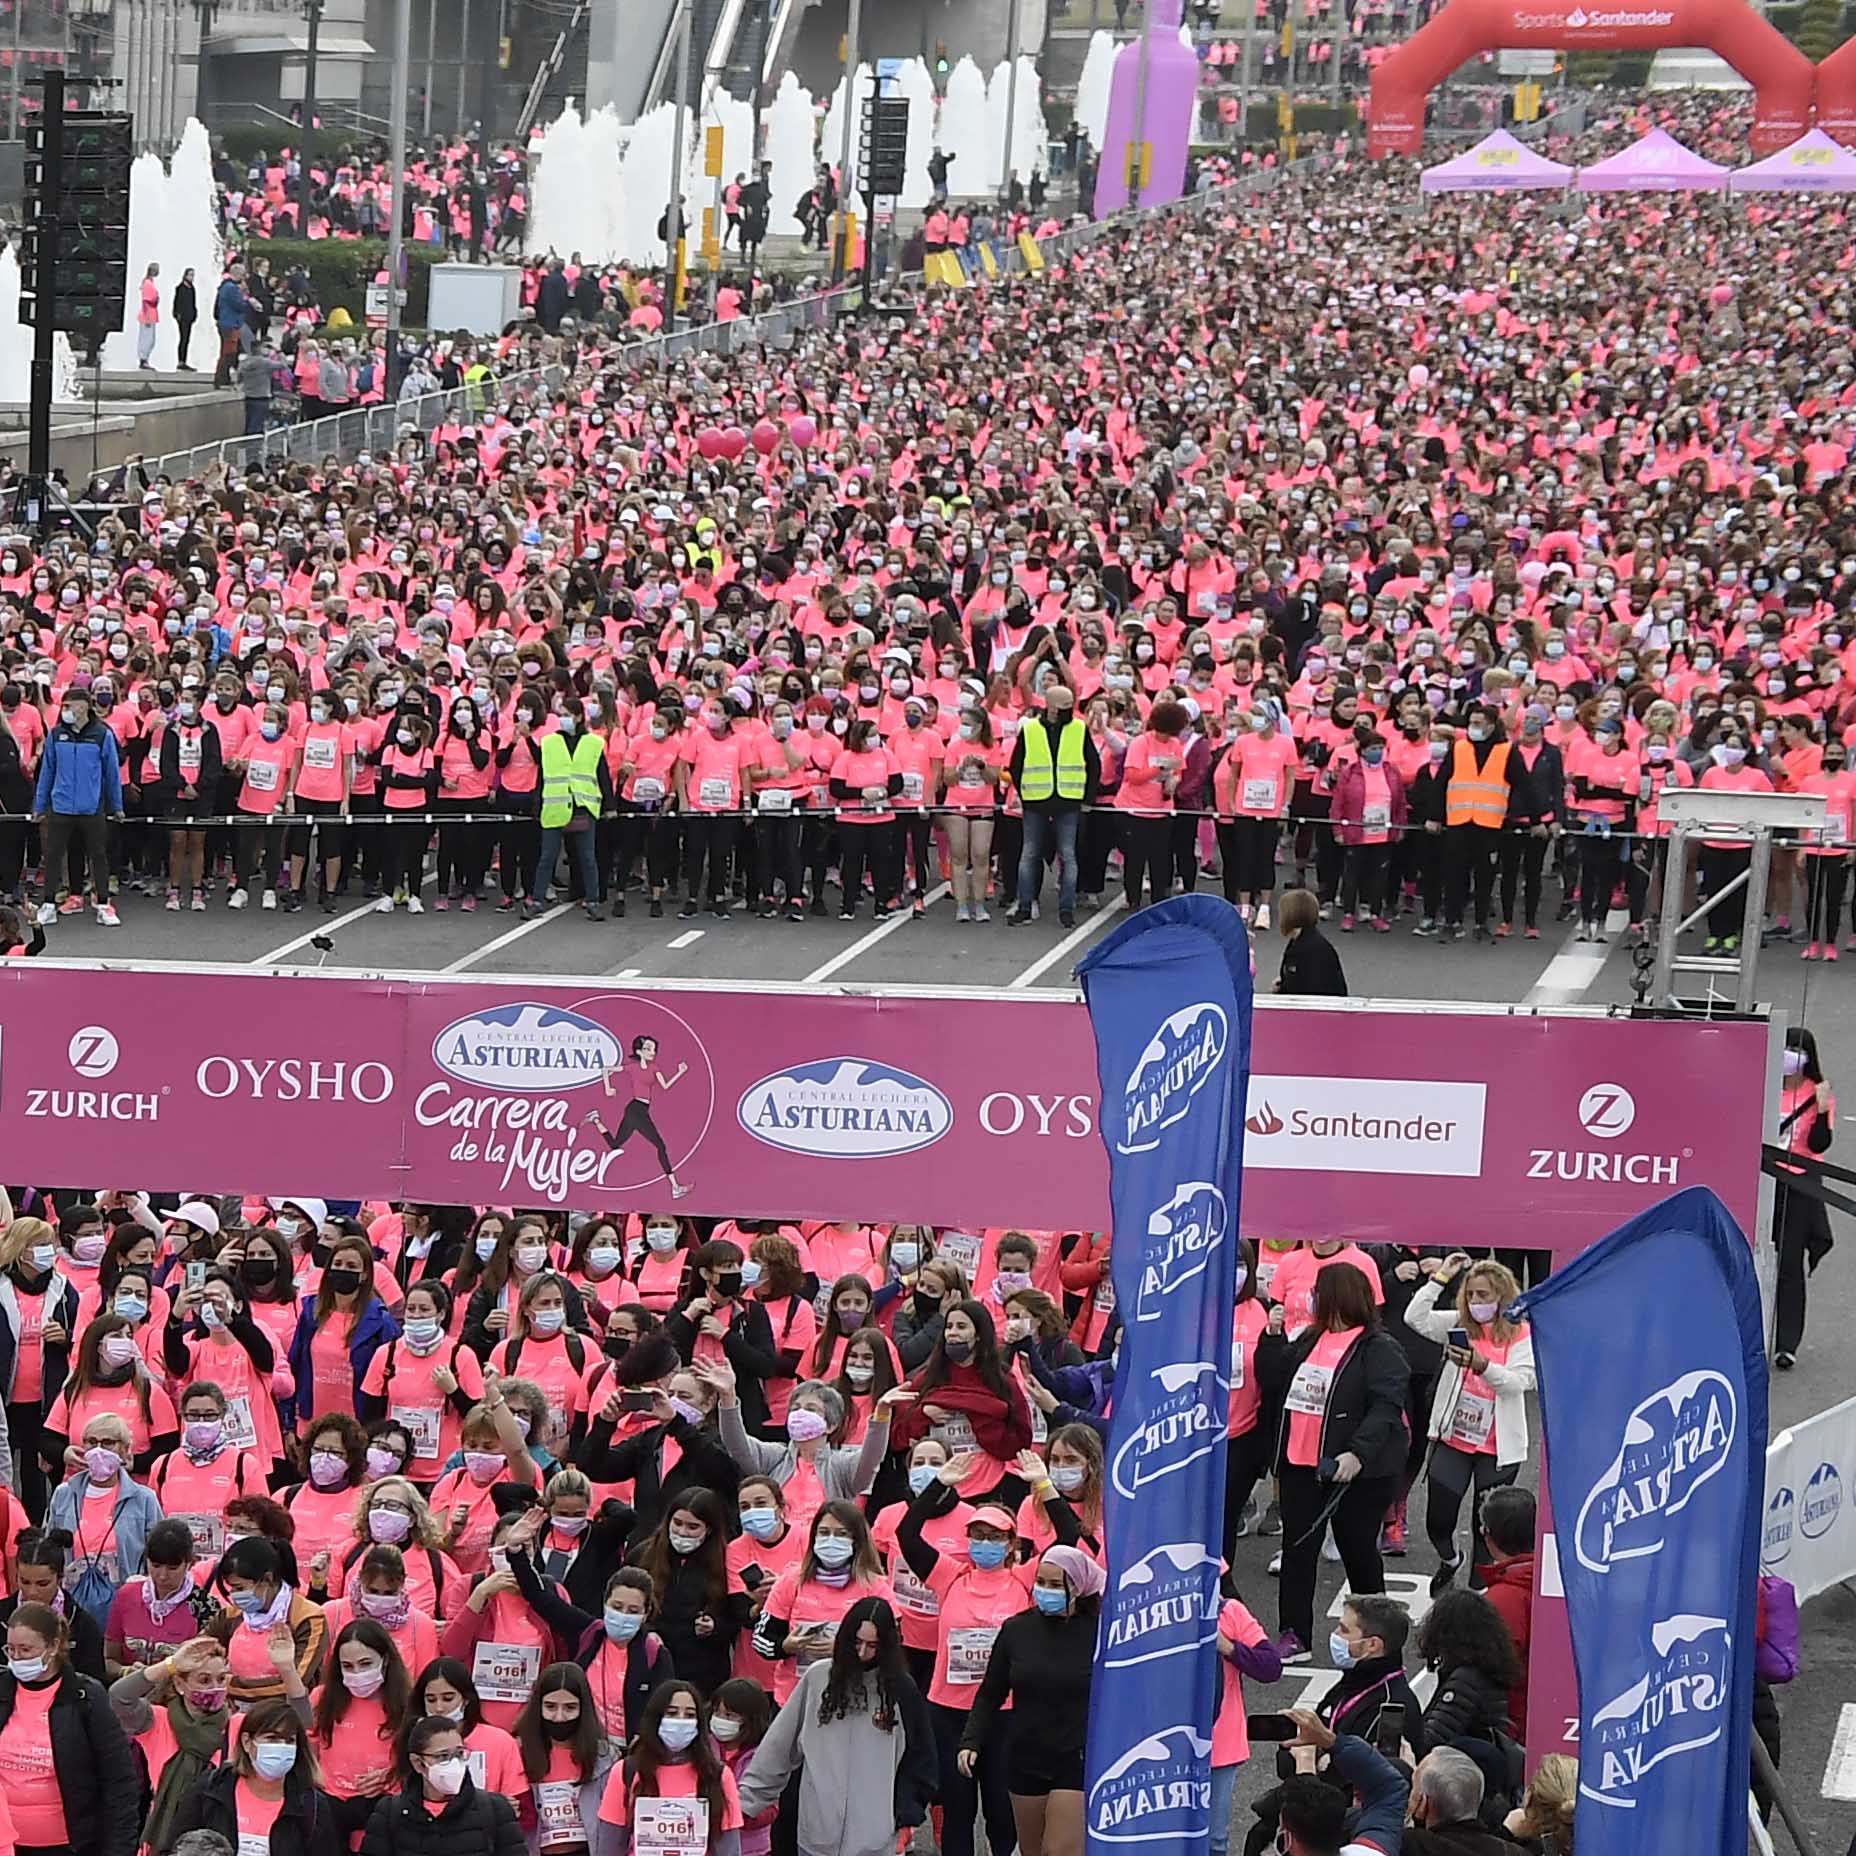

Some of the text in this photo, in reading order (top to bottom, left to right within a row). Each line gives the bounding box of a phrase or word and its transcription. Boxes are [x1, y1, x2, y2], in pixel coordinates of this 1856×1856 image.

[1514, 10, 1675, 29] Sports Santander
[448, 1033, 606, 1070] ASTURIANA
[197, 1056, 393, 1103] OYSHO
[26, 1089, 159, 1120] ZURICH
[414, 1081, 569, 1132] Carrera
[757, 1092, 933, 1133] ASTURIANA
[788, 1091, 928, 1104] CENTRAL LECHERA
[979, 1092, 1099, 1137] OYS
[1292, 1110, 1456, 1143] Santander
[450, 1128, 623, 1202] de la Mujer
[1526, 1150, 1679, 1184] ZURICH
[657, 1822, 685, 1835] 016
